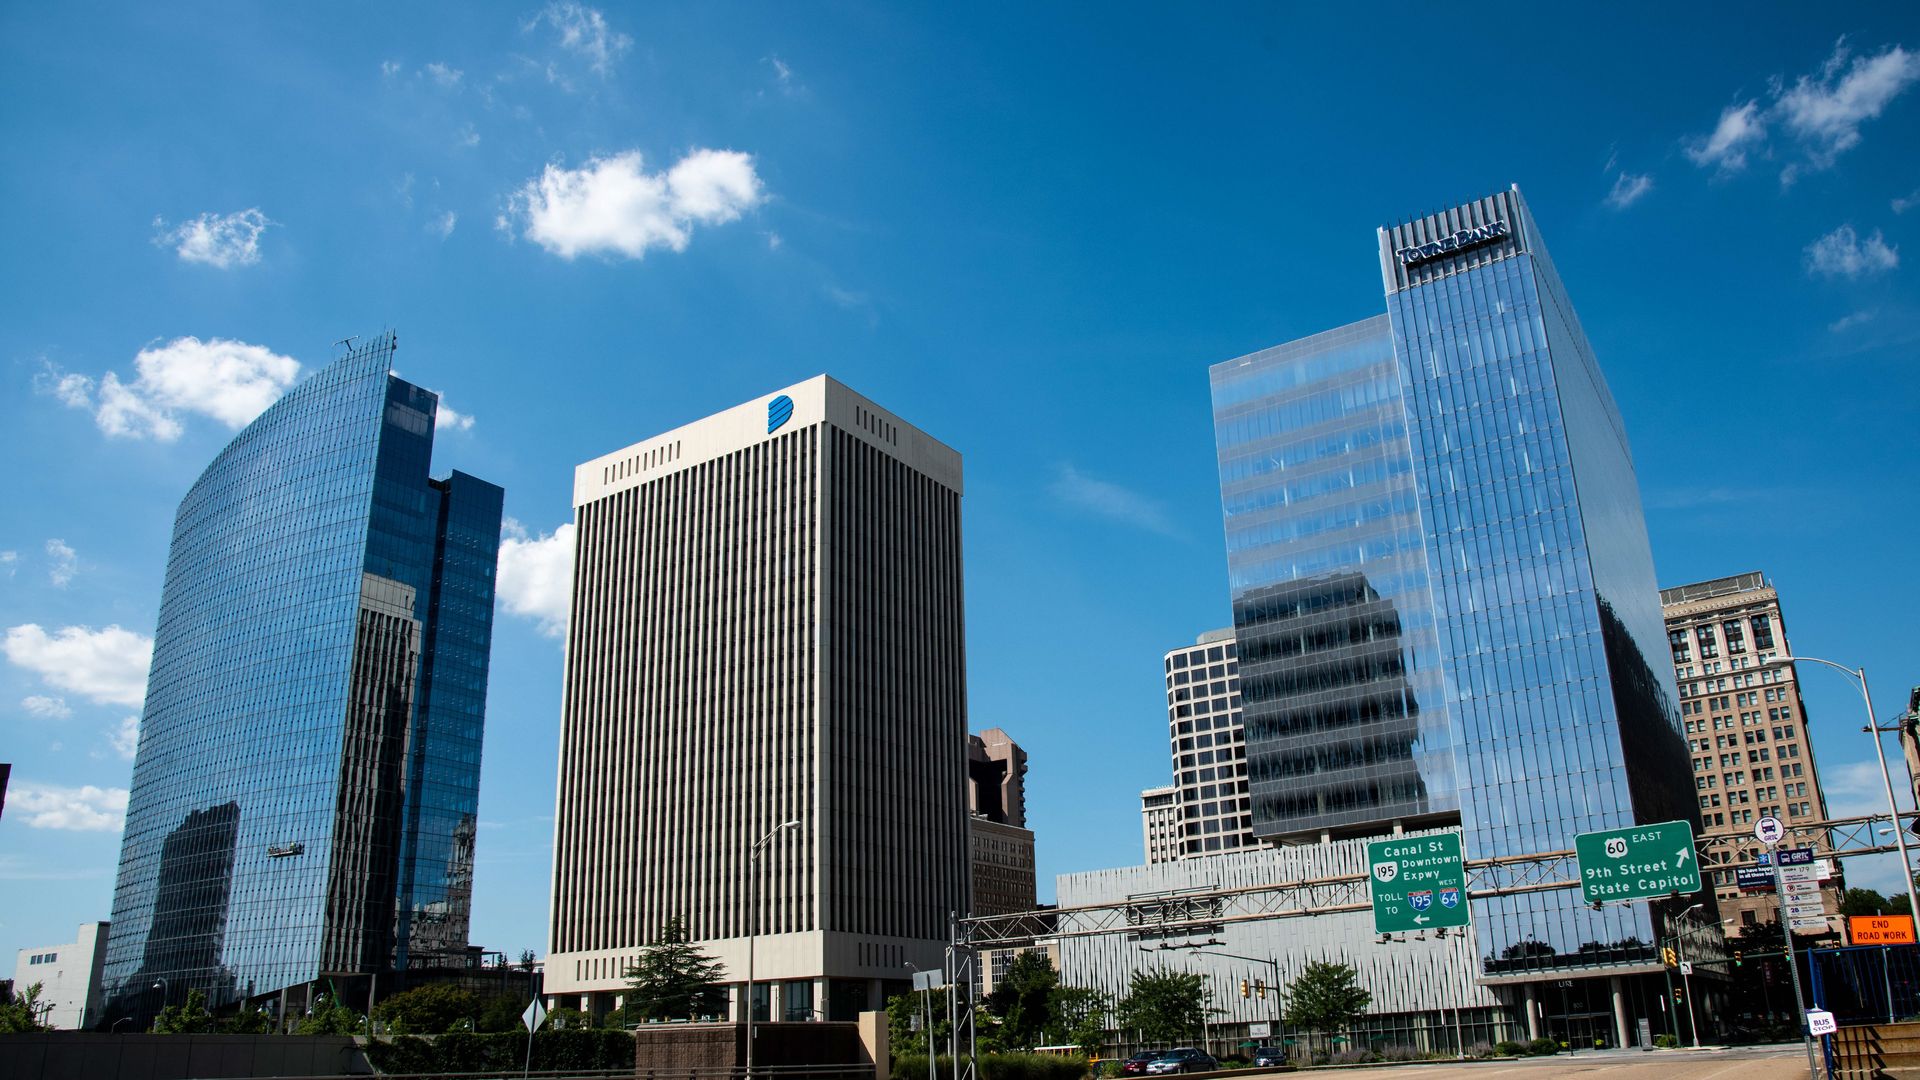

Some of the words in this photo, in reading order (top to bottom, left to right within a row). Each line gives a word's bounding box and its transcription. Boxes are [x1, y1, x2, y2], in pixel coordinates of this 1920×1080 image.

[1607, 841, 1625, 854] 60
[1632, 831, 1662, 843] EAST
[1384, 844, 1422, 857] Canal
[1429, 842, 1443, 852] St
[1791, 852, 1809, 860] GRTC
[1377, 866, 1394, 877] 195
[1402, 855, 1459, 868] Downtown
[1586, 867, 1612, 879] 9th
[1620, 860, 1668, 875] Street
[1403, 870, 1440, 881] Expwy
[1438, 878, 1457, 886] WEST
[1589, 882, 1630, 895] State
[1638, 874, 1694, 891] Capitol
[1378, 893, 1403, 902] TOLL
[1411, 895, 1431, 908] 195
[1441, 892, 1458, 904] 64
[1385, 906, 1398, 915] TO
[1871, 920, 1889, 929] END
[1857, 931, 1880, 940] ROAD
[1883, 930, 1907, 939] WORK
[1813, 1018, 1830, 1027] BUS
